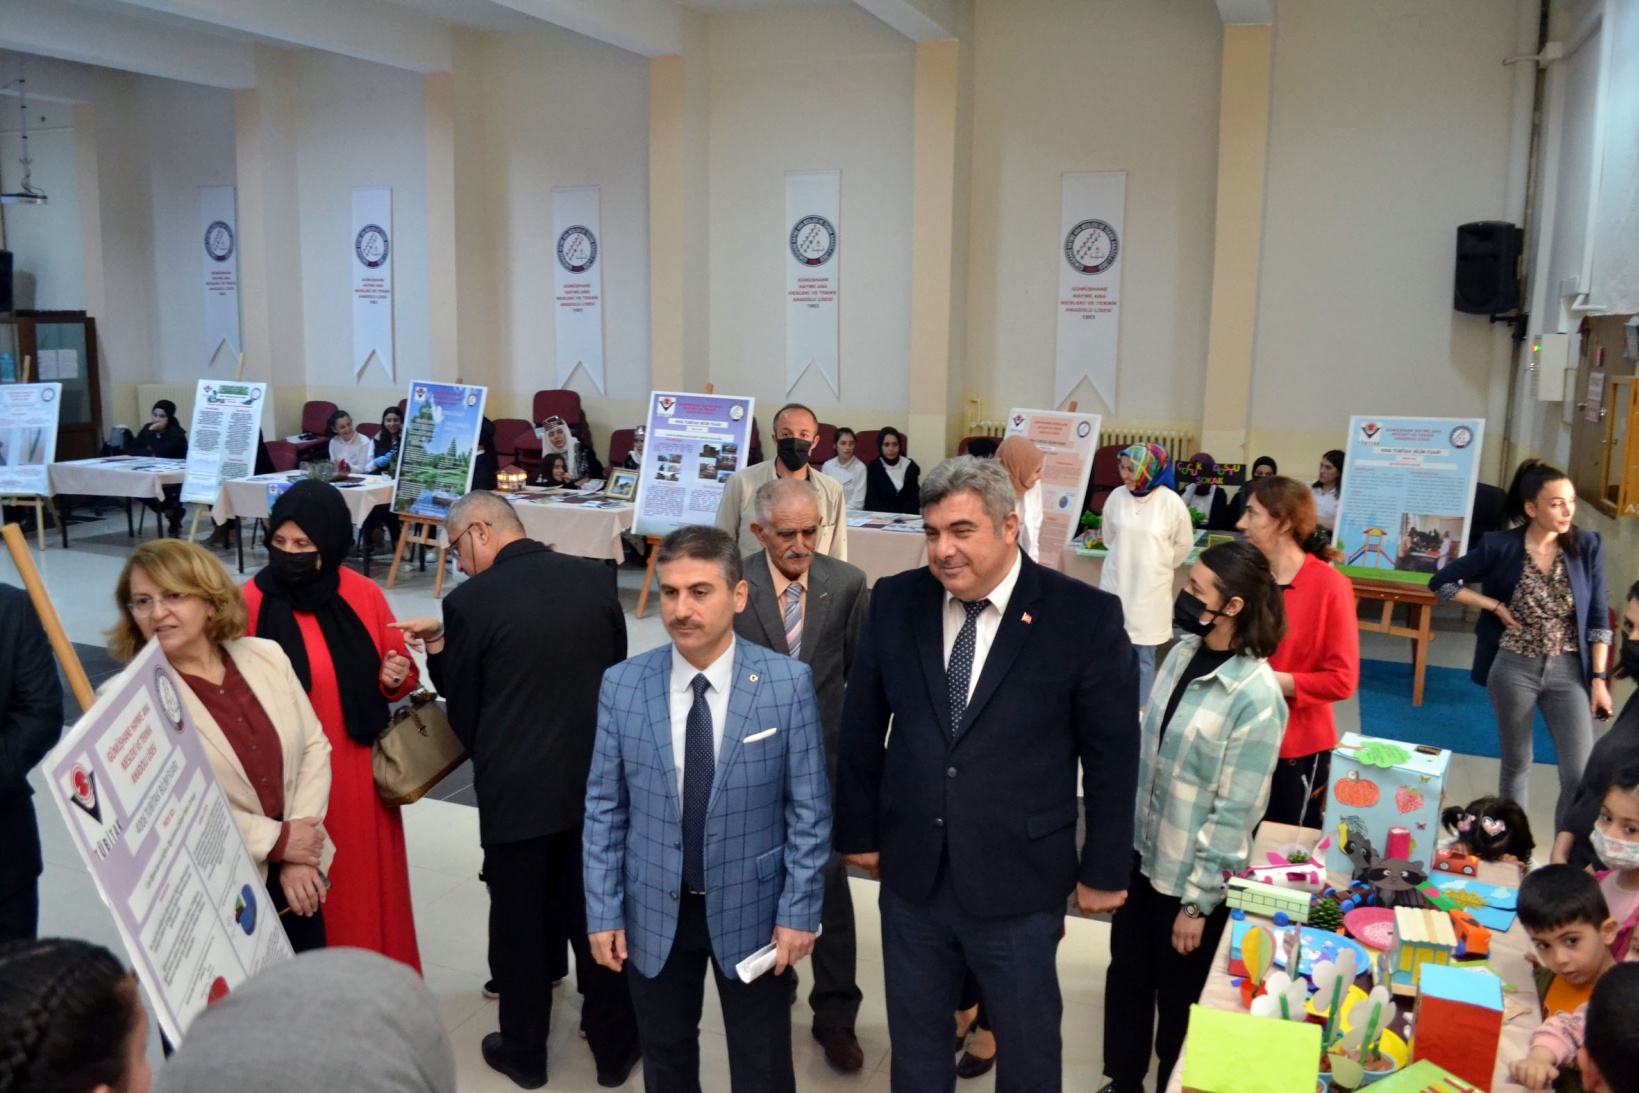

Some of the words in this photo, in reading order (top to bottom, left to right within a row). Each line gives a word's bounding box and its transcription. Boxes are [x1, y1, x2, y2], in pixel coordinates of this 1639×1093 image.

[1176, 462, 1203, 476] ÇOCUK
[1212, 464, 1241, 476] DOSTU
[1196, 476, 1224, 486] SOKAK
[107, 727, 132, 763] GÜMÜŞHANE
[132, 757, 148, 784] ANADOLU
[94, 819, 124, 864] TÜBİTAK
